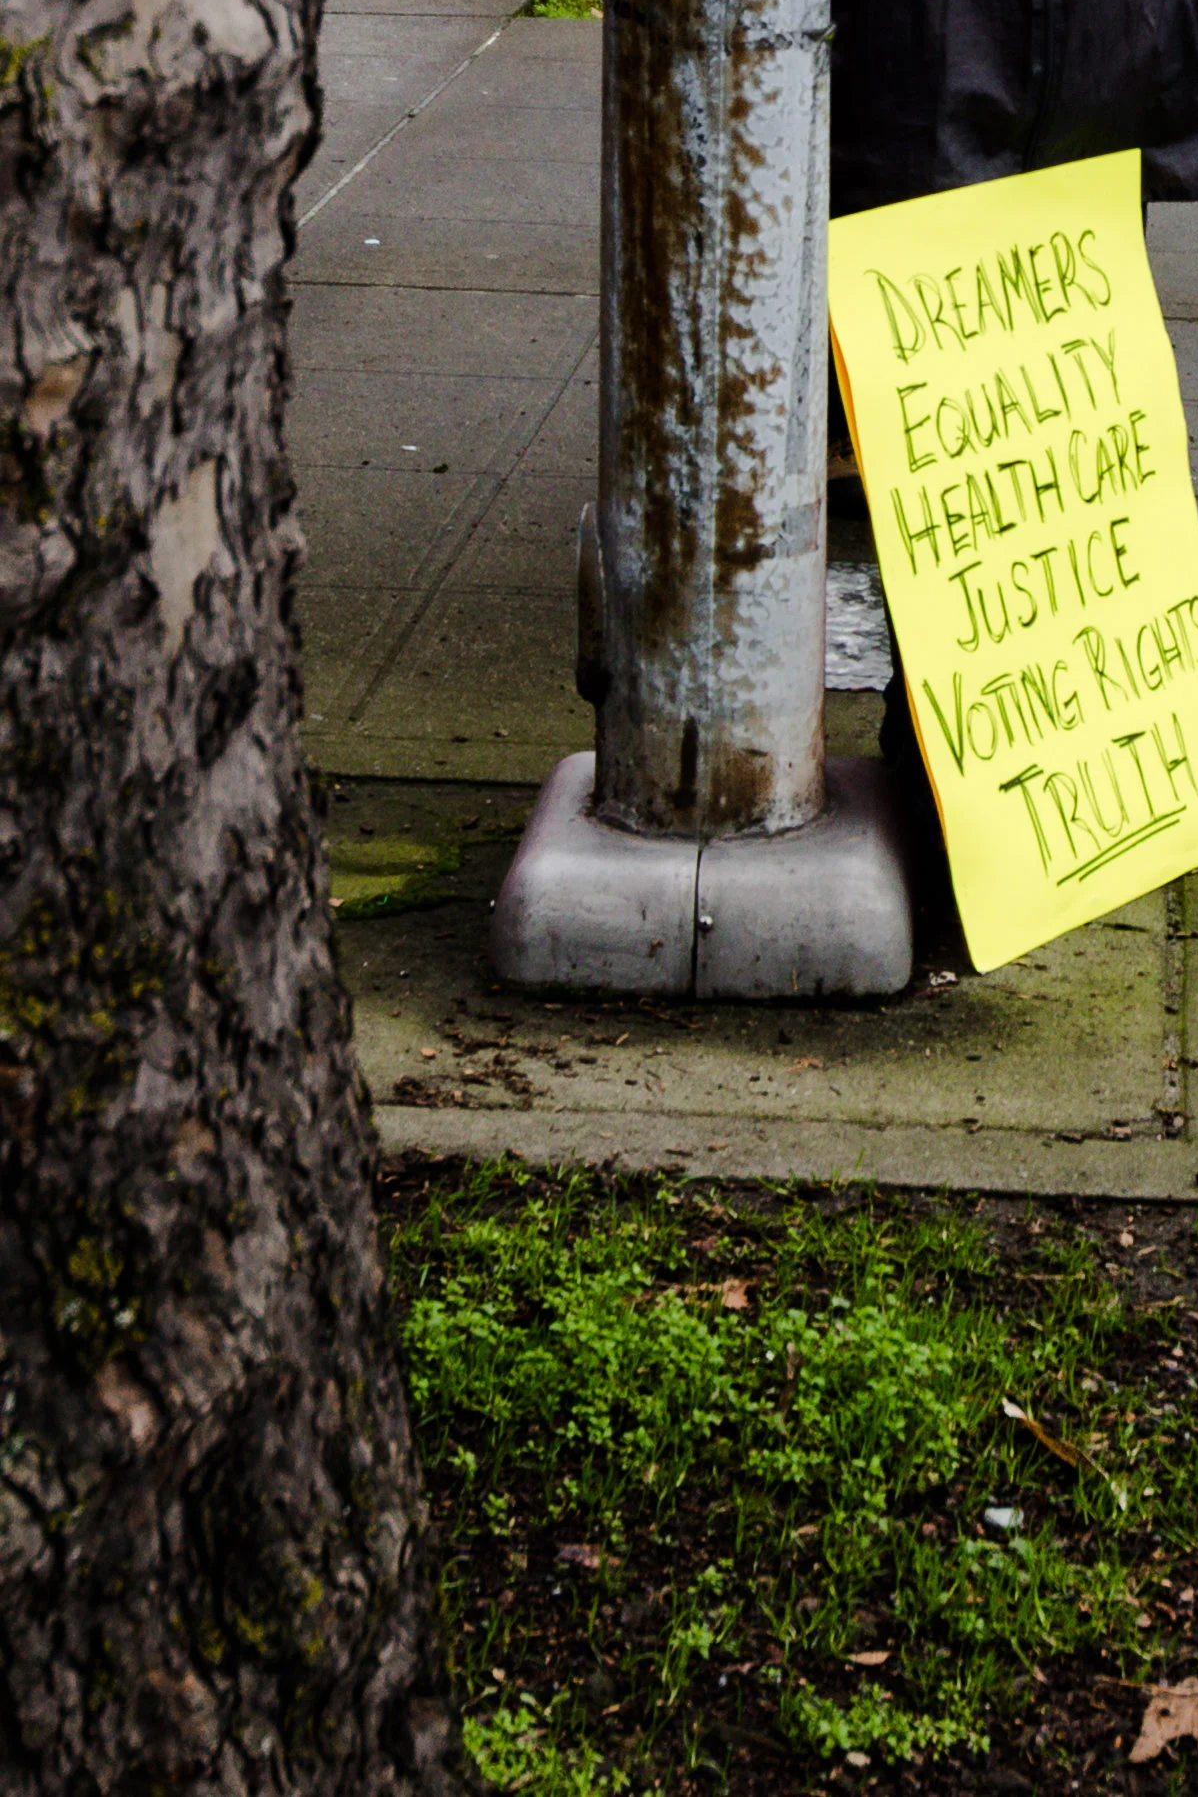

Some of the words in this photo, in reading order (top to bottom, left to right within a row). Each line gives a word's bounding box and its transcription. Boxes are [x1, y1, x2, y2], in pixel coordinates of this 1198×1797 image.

[864, 229, 1111, 366] DREAMERS
[896, 328, 1121, 473] EQUALITY
[948, 517, 1140, 653] JUSTICE
[922, 660, 1085, 778] VOTING
